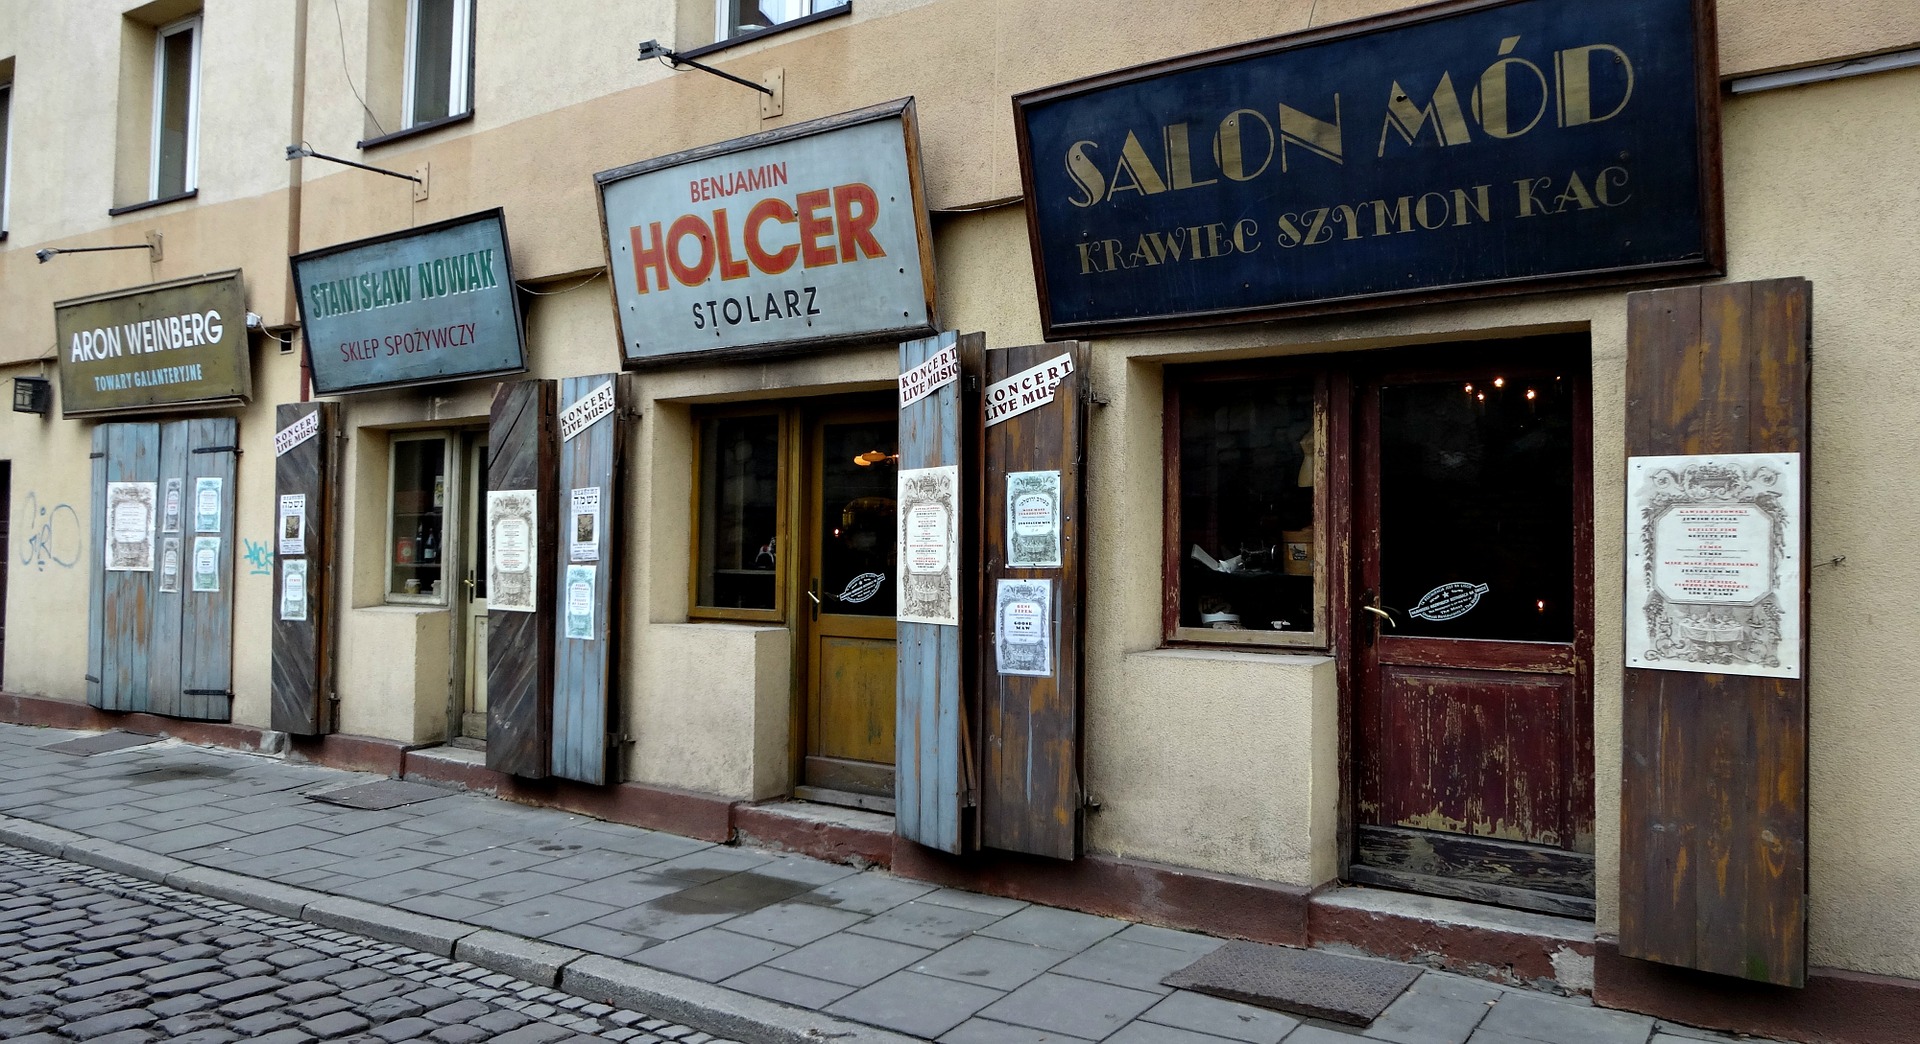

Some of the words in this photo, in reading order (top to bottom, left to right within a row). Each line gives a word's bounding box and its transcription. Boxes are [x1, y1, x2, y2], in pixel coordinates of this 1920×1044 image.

[1064, 93, 1344, 208] SALON
[1377, 35, 1634, 157] MÓD
[690, 161, 788, 203] BENJAMIN
[630, 182, 887, 295] HOLCER
[1076, 218, 1262, 275] KRAWIEC
[1277, 184, 1492, 248] SZYMON
[1514, 166, 1632, 219] KAC
[310, 265, 413, 321] STANISŁAW
[418, 249, 498, 301] NOWAK
[692, 286, 821, 330] STOLARZ
[71, 326, 122, 363] ARON
[124, 309, 223, 355] WEINBERG
[340, 338, 379, 363] SKLEP
[384, 322, 476, 357] SPOŻYWCZY
[94, 372, 132, 392] TOWARY
[134, 363, 203, 387] GALANTERYJNE
[901, 347, 957, 389] KONCERT
[903, 381, 926, 403] LIVE
[928, 362, 958, 389] MUSIC
[985, 360, 1071, 407] KONCERT
[561, 386, 611, 427] KONCERT
[563, 417, 582, 437] LIVE
[584, 397, 613, 424] MUSIC
[985, 398, 1018, 422] LIVE
[275, 414, 317, 445] KONCERT
[276, 439, 293, 453] LIVE
[294, 423, 318, 443] MUSIC
